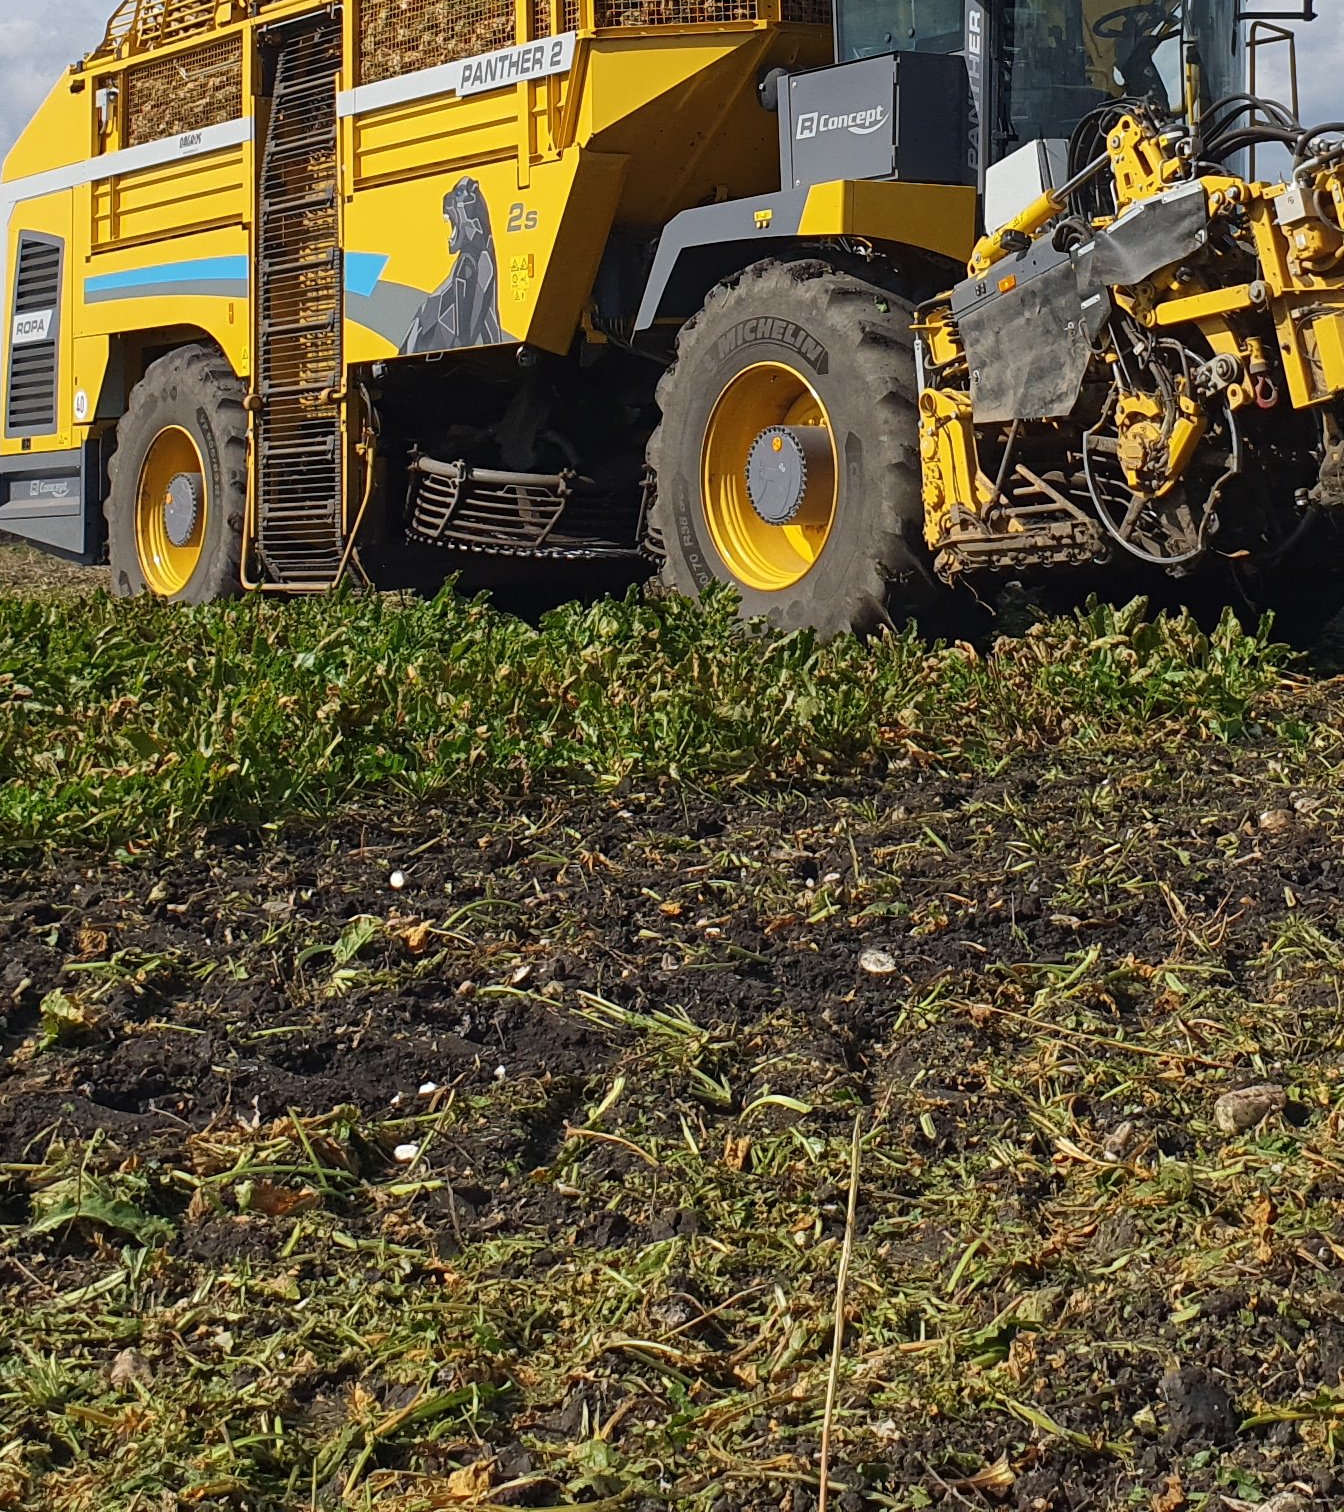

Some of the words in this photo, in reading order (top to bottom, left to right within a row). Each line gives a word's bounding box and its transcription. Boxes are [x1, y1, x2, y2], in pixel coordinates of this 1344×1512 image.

[460, 45, 545, 90] PANTHER
[549, 40, 563, 68] 2
[967, 9, 981, 170] PANTHER
[819, 105, 884, 132] Concept
[506, 202, 538, 233] 2s
[16, 318, 45, 336] ROPA
[716, 317, 825, 362] MICHELIN
